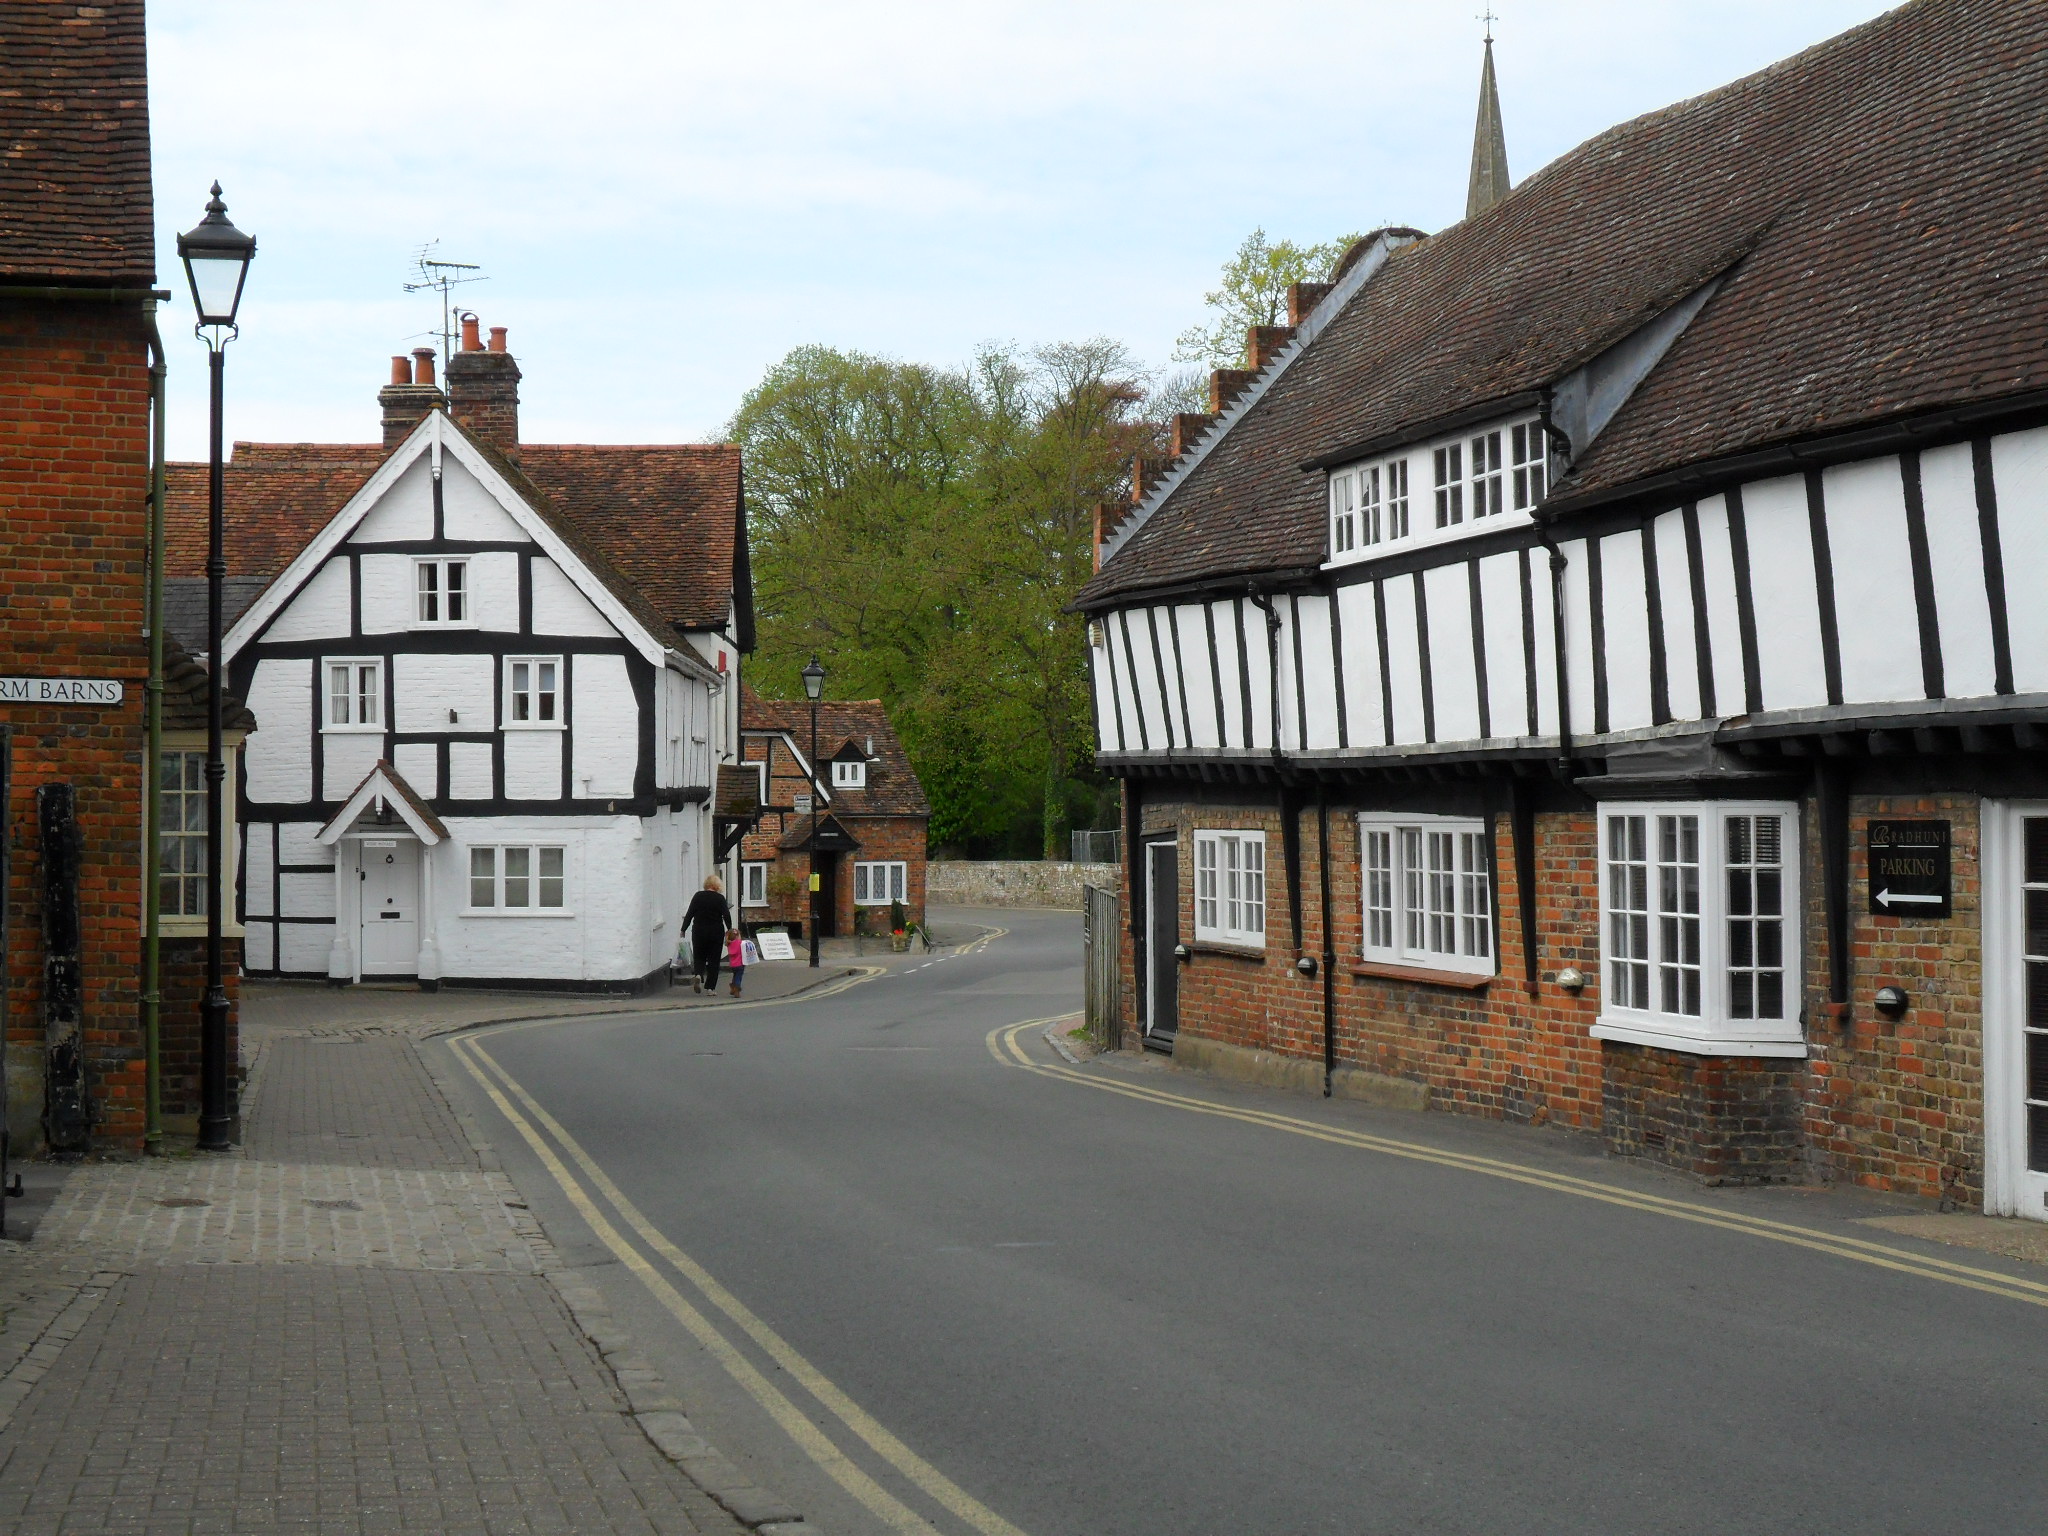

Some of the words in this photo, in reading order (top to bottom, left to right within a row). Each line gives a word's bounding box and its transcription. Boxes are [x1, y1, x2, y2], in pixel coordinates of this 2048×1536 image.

[40, 682, 116, 700] BARNS
[1891, 831, 1946, 843] RADHUNI
[1880, 858, 1935, 876] PARKING
